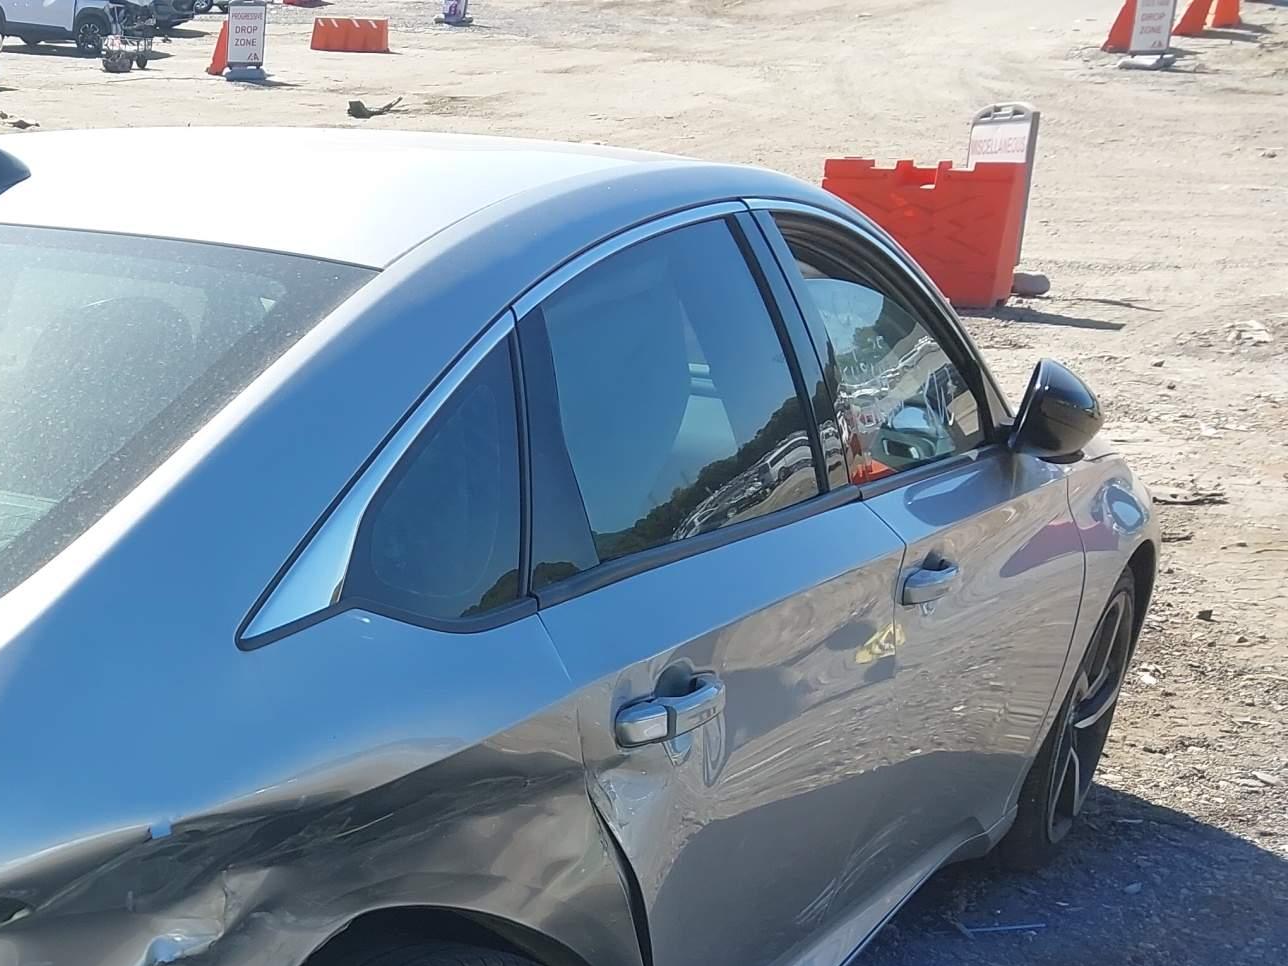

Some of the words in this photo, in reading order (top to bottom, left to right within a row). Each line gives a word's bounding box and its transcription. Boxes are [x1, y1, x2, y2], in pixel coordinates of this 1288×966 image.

[1141, 12, 1166, 21] DROP
[235, 25, 258, 34] DROP
[234, 38, 257, 47] ZONE
